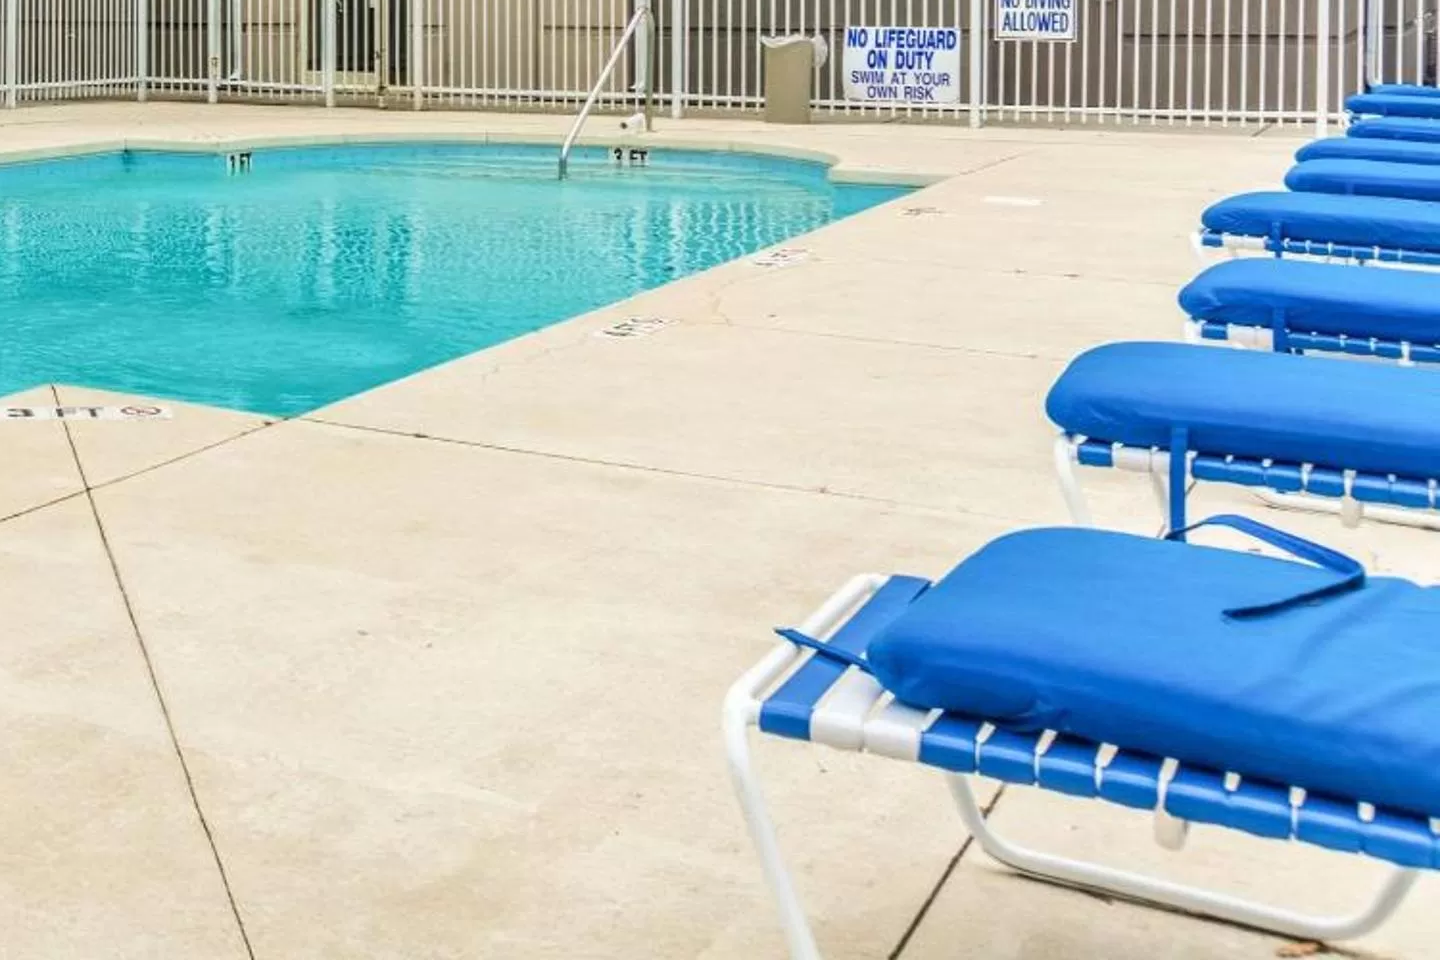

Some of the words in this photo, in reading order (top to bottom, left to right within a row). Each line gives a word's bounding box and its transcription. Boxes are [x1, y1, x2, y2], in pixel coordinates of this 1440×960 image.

[1002, 11, 1069, 33] ALLOWED
[847, 28, 868, 48] NO
[875, 28, 957, 50] LIFEGUARD
[867, 49, 888, 70] ON
[895, 50, 935, 70] DUTY
[851, 70, 884, 85] SWIM
[891, 72, 907, 85] AT
[914, 72, 951, 87] YOUR
[867, 85, 898, 99] OWN
[904, 86, 935, 101] RISK
[6, 407, 35, 418] 3
[54, 406, 105, 419] FT
